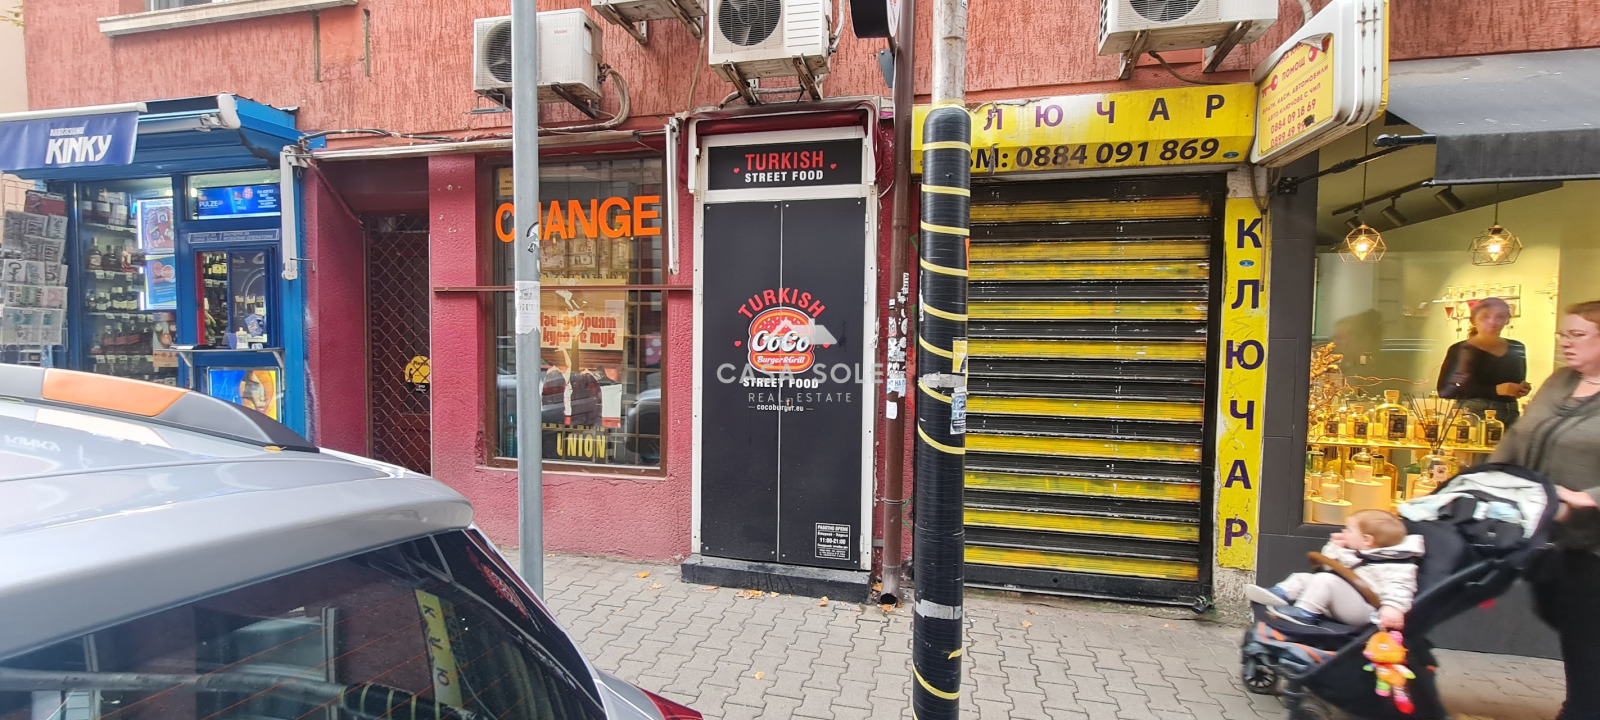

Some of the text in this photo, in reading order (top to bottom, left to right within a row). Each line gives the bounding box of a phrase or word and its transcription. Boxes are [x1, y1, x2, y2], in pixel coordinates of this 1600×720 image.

[984, 94, 1225, 131] ЛЮЧАР
[1271, 117, 1286, 134] 0884
[1287, 111, 1296, 124] 09
[1297, 105, 1305, 118] 18
[1307, 98, 1316, 112] 69
[45, 135, 113, 164] KINKY
[744, 151, 824, 171] TURKISH
[1016, 145, 1087, 168] 0884
[1096, 141, 1149, 166] 091
[1158, 138, 1220, 162] 869
[745, 169, 824, 183] STREET FOOD
[495, 195, 661, 242] CANGE
[738, 287, 826, 318] TURKISH
[590, 329, 616, 348] тук
[752, 330, 810, 352] CoCo
[757, 355, 806, 365] Burger&Grill
[743, 377, 819, 389] STREET FOOD
[1224, 217, 1265, 547] КЛЮЧАР
[756, 403, 804, 413] cocoburger.eu
[556, 433, 606, 459] UNION
